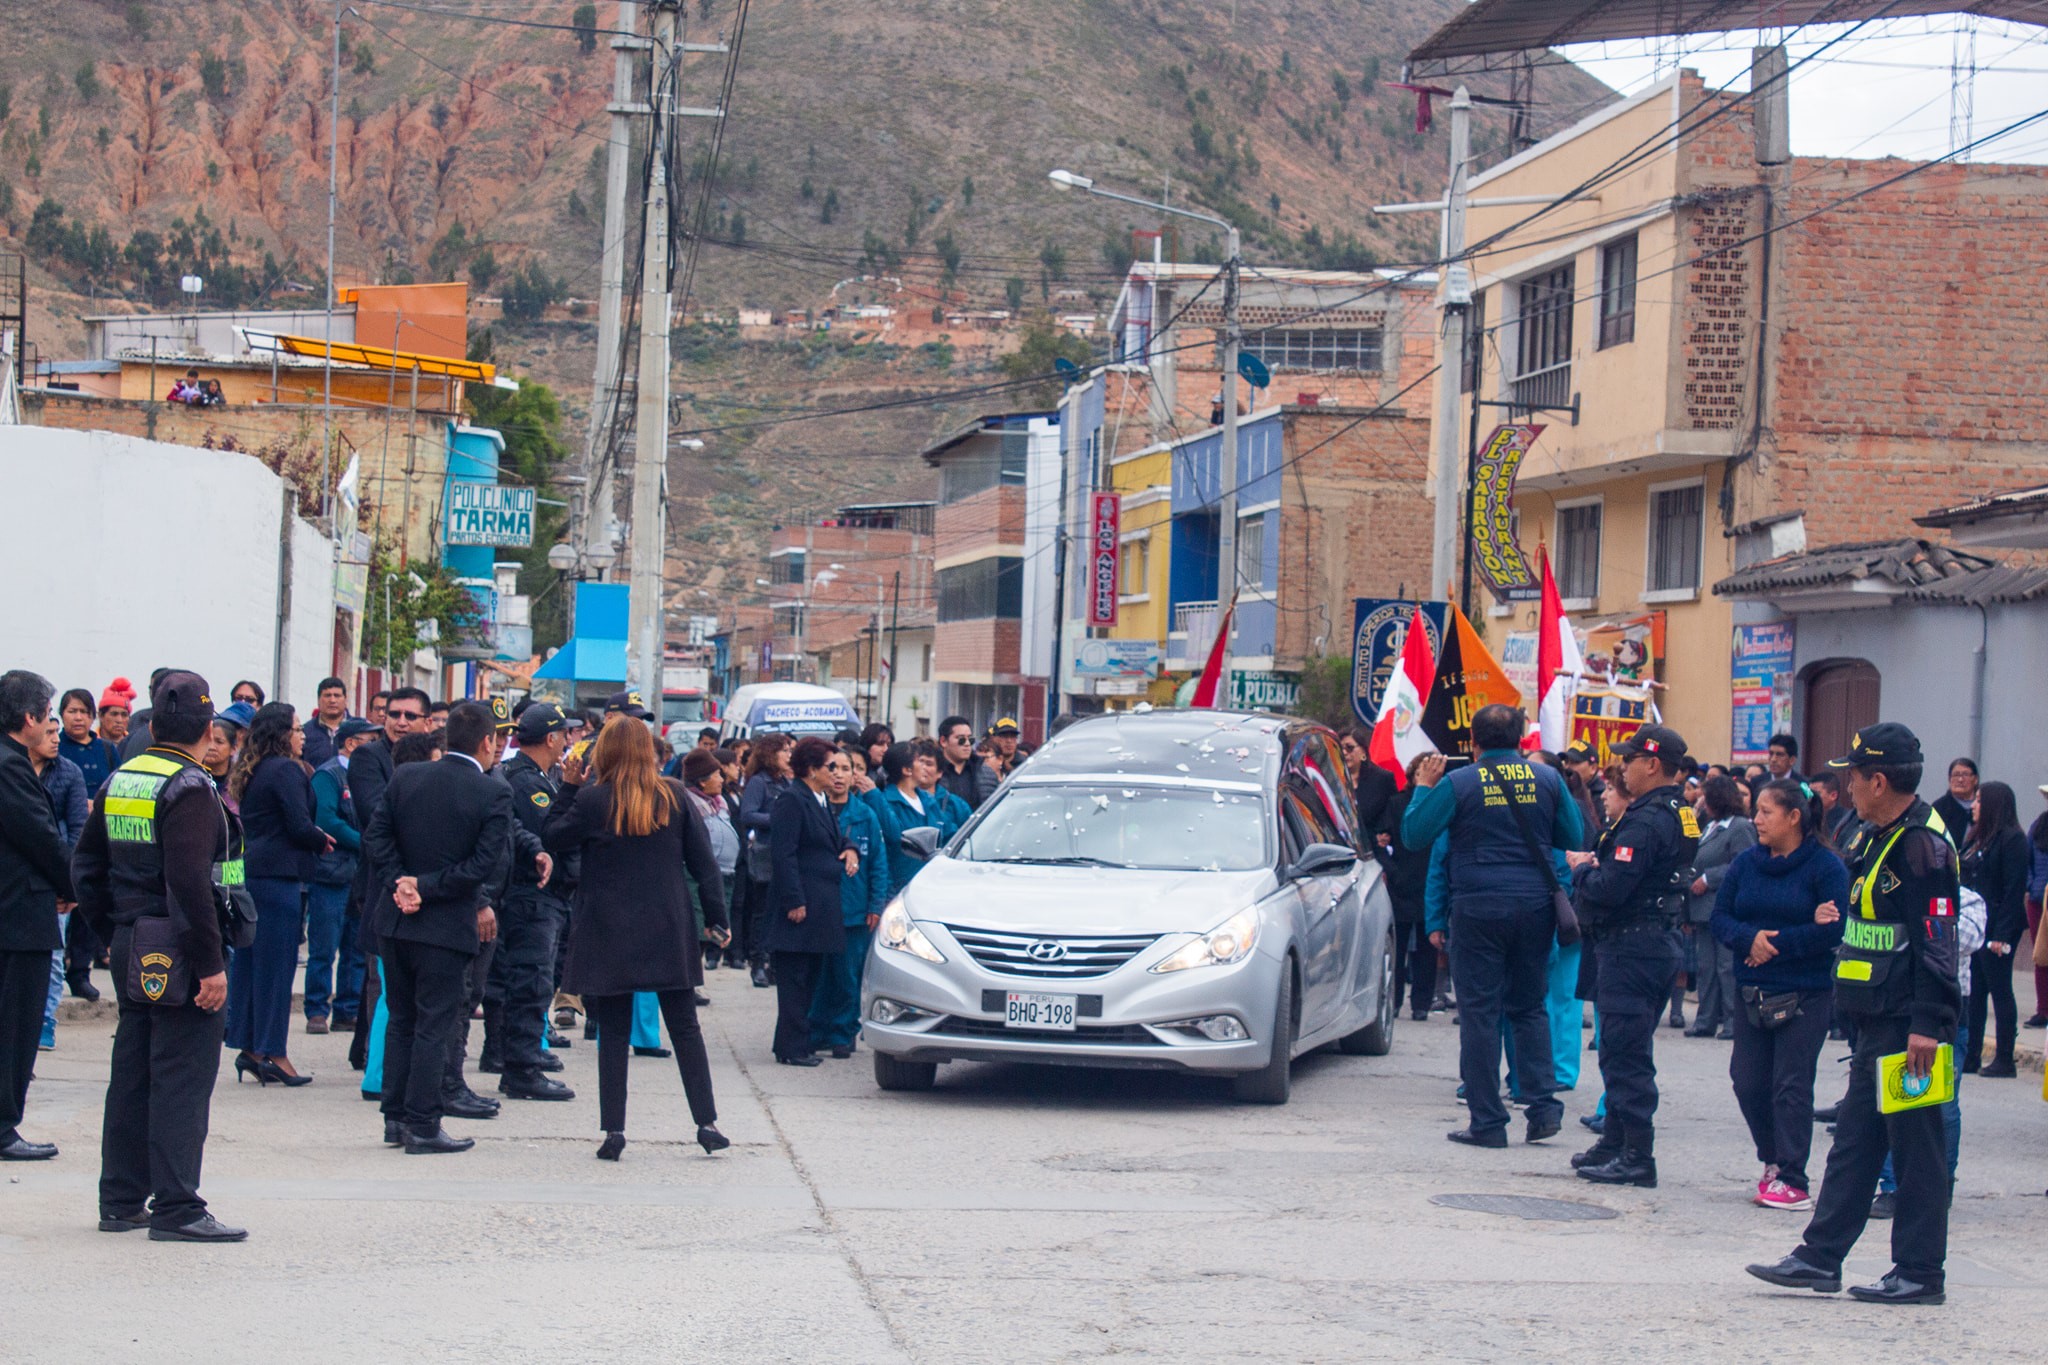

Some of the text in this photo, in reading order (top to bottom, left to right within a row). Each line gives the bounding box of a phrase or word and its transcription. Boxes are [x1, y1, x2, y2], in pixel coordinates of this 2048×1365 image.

[453, 485, 534, 513] POLICLINICO
[1473, 428, 1515, 586] EL SABROSON
[452, 508, 532, 535] TARMA
[1494, 449, 1529, 585] RESTAURANT
[450, 530, 483, 543] PARTOS
[1097, 520, 1115, 620] LOS ANGELES
[1360, 605, 1396, 647] SUPERIOR
[1357, 648, 1370, 698] INSTITUTO
[767, 707, 846, 717] PACHECO ACOBAMBA
[1514, 783, 1525, 793] TV
[106, 815, 153, 843] TRANSITO
[1029, 994, 1055, 1003] PERU
[1009, 1001, 1073, 1025] BHQ-198
